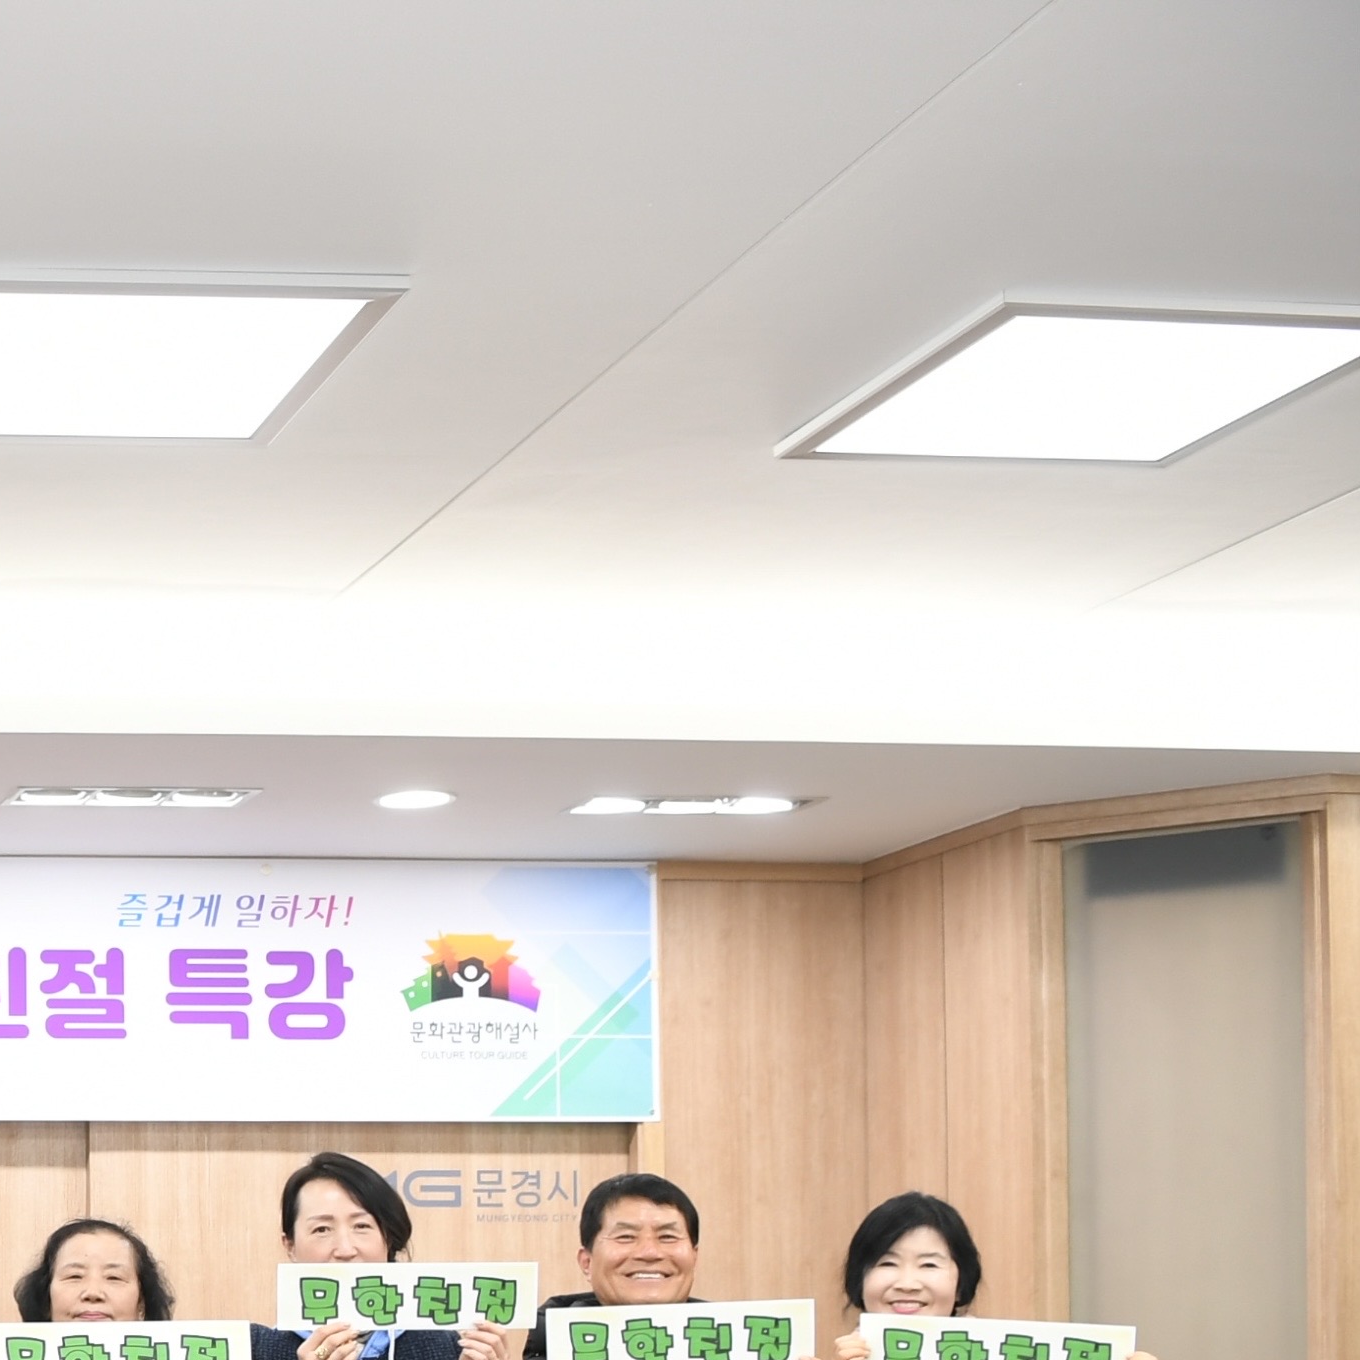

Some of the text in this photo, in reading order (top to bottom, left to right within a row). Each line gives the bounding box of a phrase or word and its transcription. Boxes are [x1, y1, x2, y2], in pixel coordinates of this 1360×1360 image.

[119, 894, 353, 927] 즐겁게 일하자!
[165, 948, 354, 1040] 특강
[413, 1022, 537, 1043] 문화관광해설사
[497, 1050, 528, 1059] GUIDE
[472, 1169, 579, 1208] 문경시
[477, 1214, 549, 1222] MUNGYEONG
